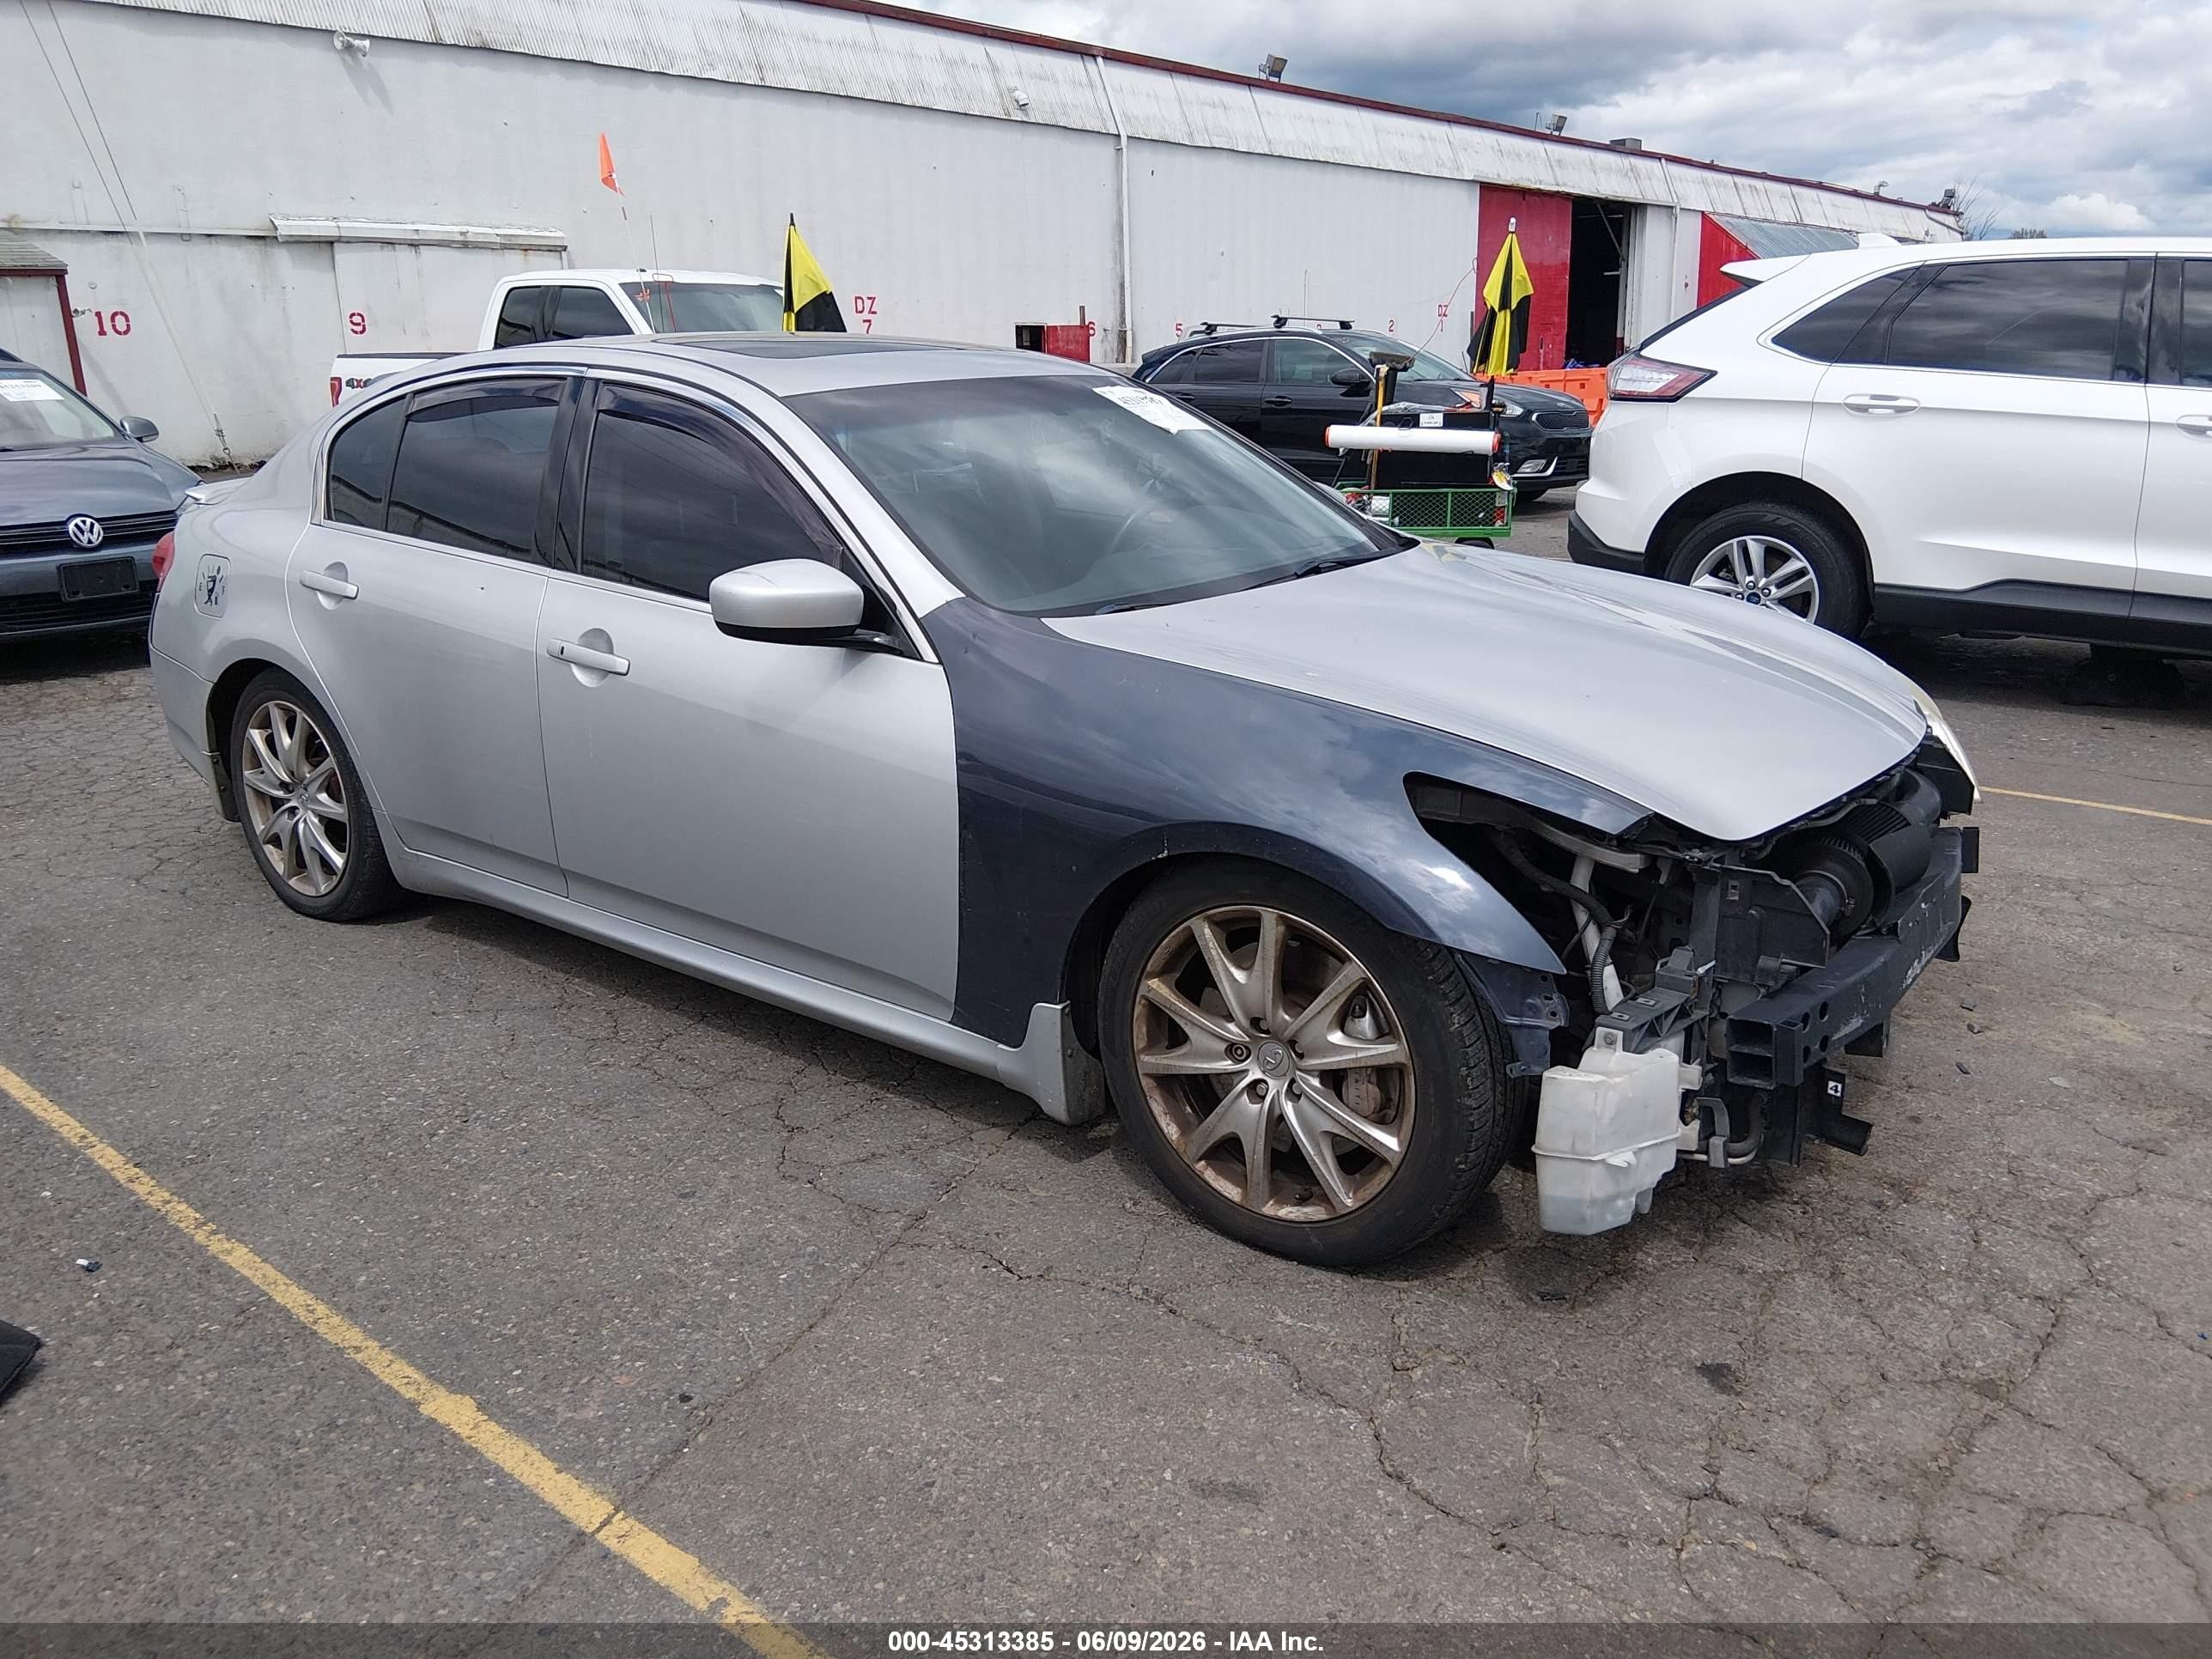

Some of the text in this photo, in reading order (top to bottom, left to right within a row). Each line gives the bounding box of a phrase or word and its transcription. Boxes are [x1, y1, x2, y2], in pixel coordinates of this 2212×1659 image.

[854, 295, 878, 314] DZ
[1437, 304, 1448, 317] DZ
[94, 311, 131, 336] 10
[349, 312, 367, 335] 9
[862, 319, 872, 334] 7
[1088, 321, 1096, 337] 6
[1176, 322, 1183, 337] 5
[1389, 319, 1395, 332] 2
[1830, 1084, 1840, 1095] 4
